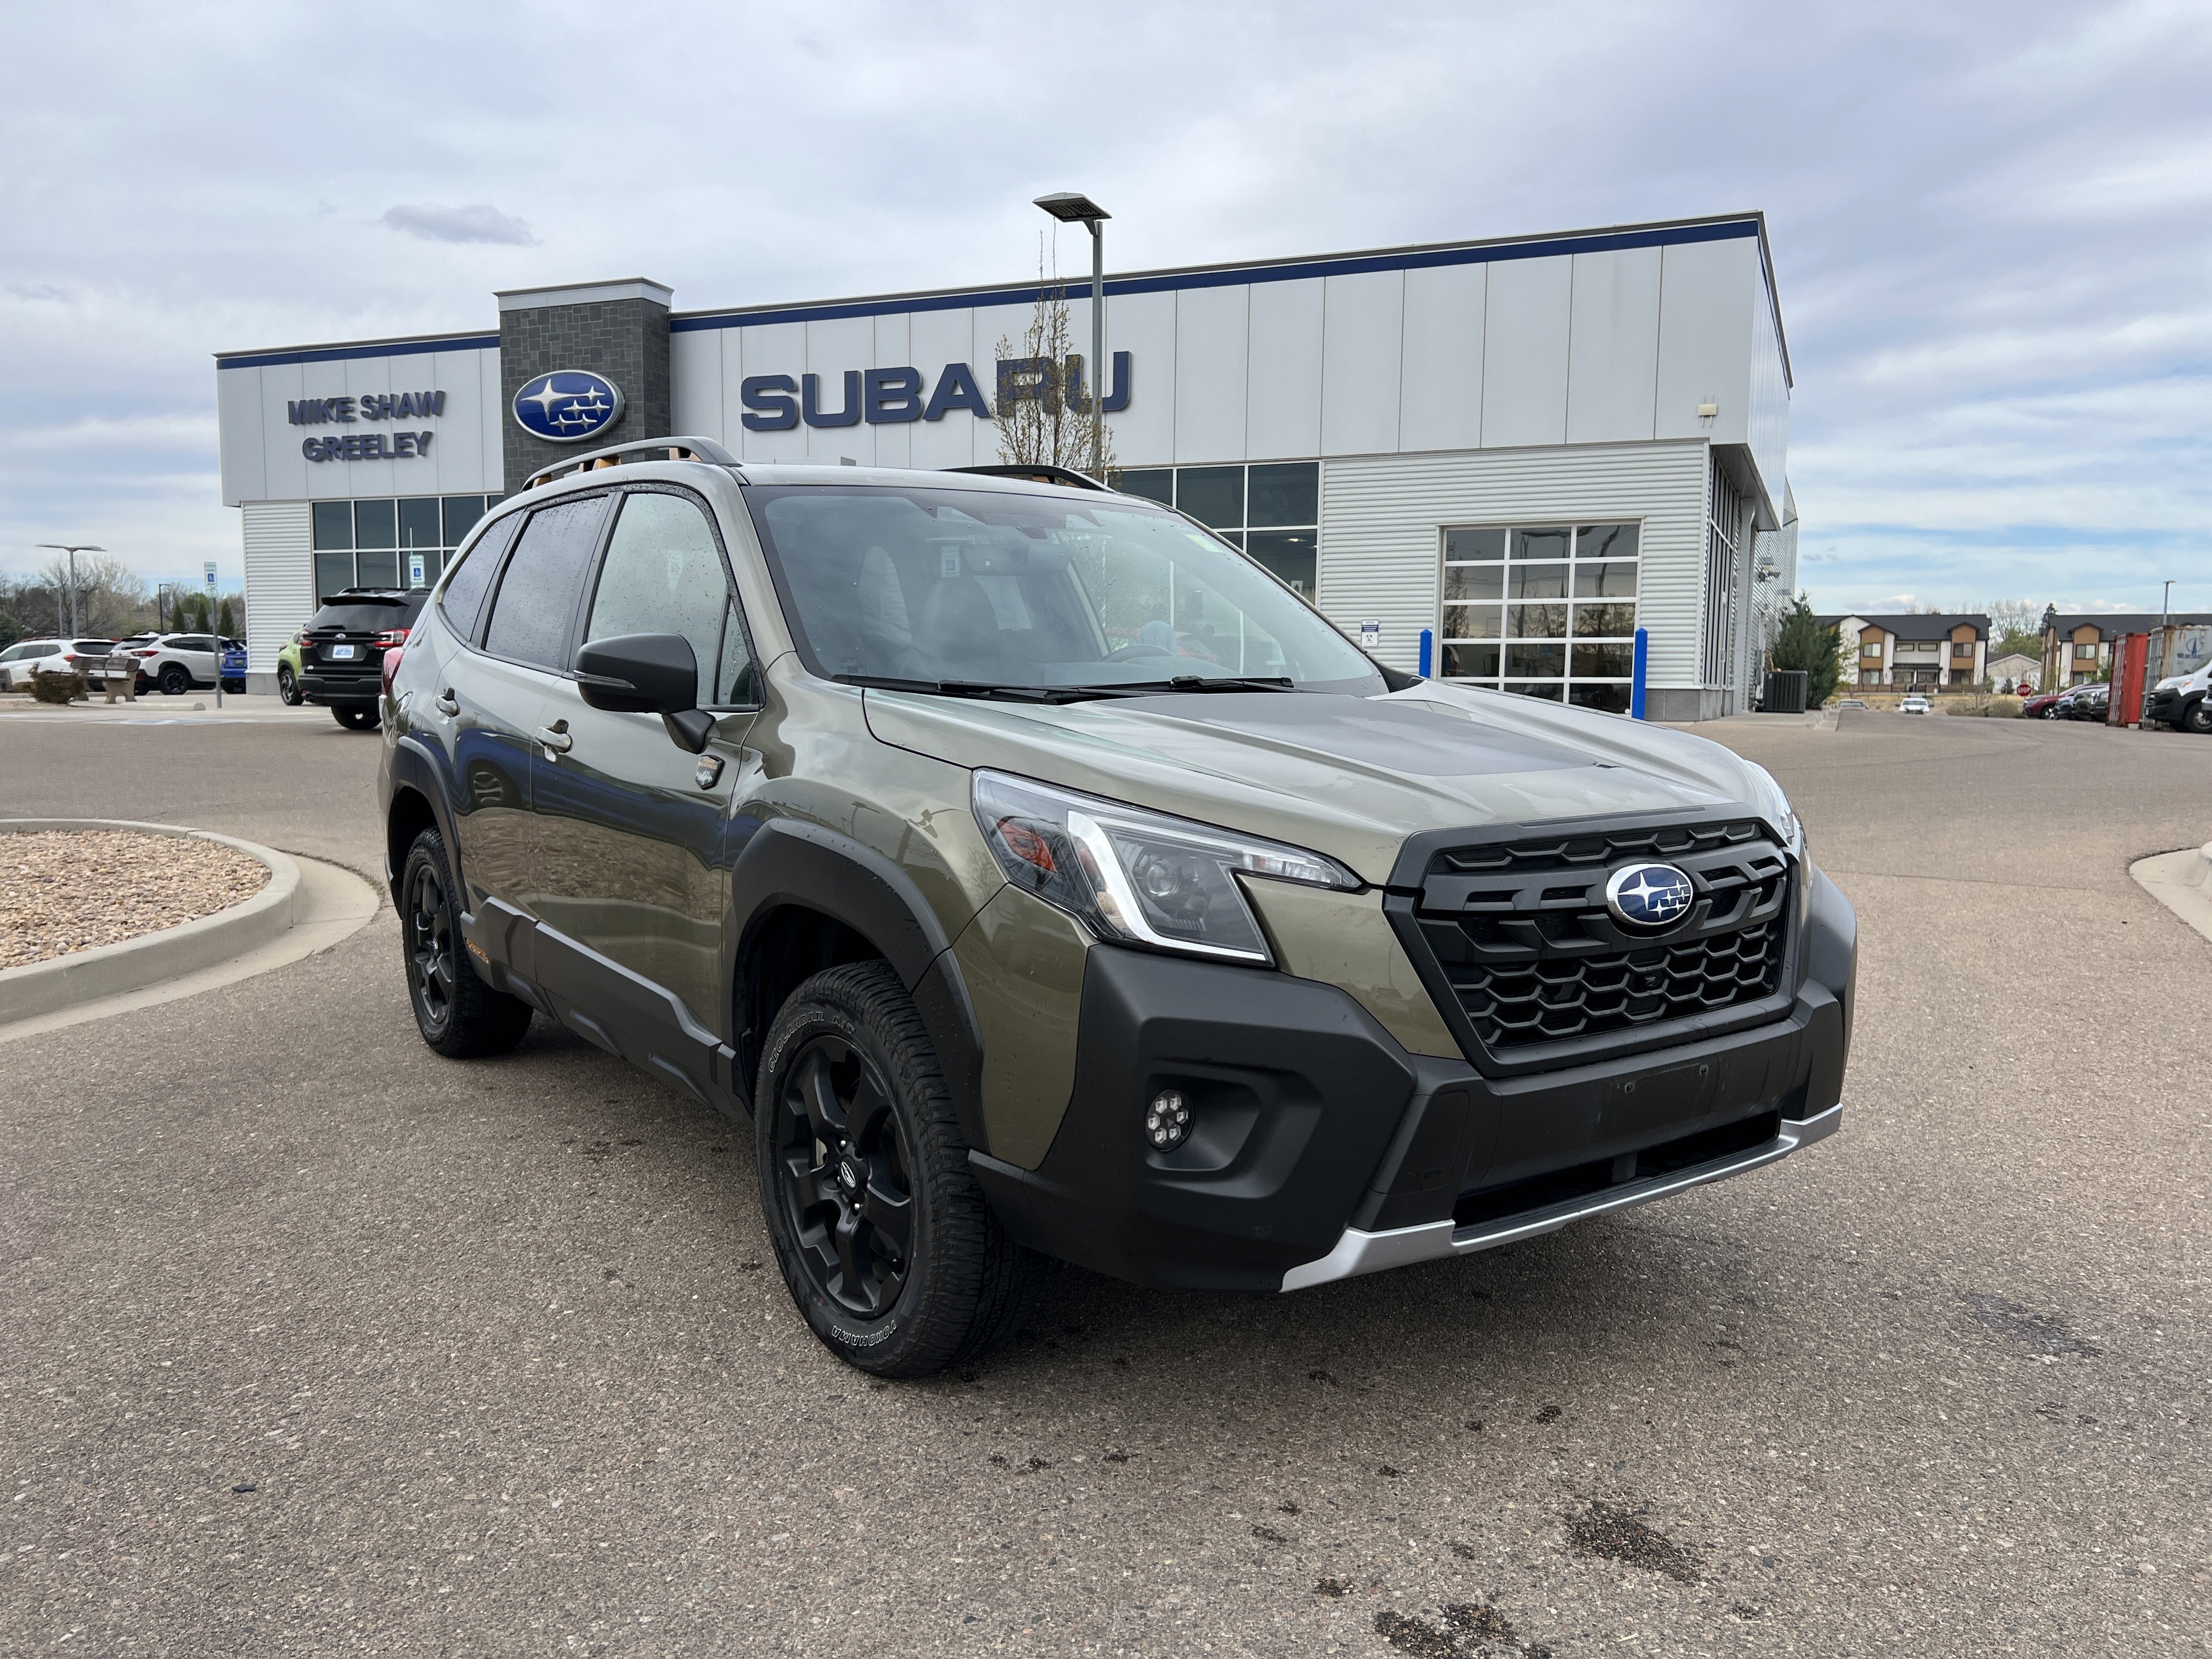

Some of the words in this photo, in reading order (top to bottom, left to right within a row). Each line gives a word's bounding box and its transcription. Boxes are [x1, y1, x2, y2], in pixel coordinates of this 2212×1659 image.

[288, 397, 356, 425] MIKE
[360, 391, 445, 420] SHAW
[741, 351, 1132, 431] SUBARU
[302, 431, 433, 462] GREELEY
[768, 1011, 824, 1073] GEOLANDAR
[833, 1015, 855, 1035] A/T
[831, 1319, 897, 1347] YOKOHAMA
